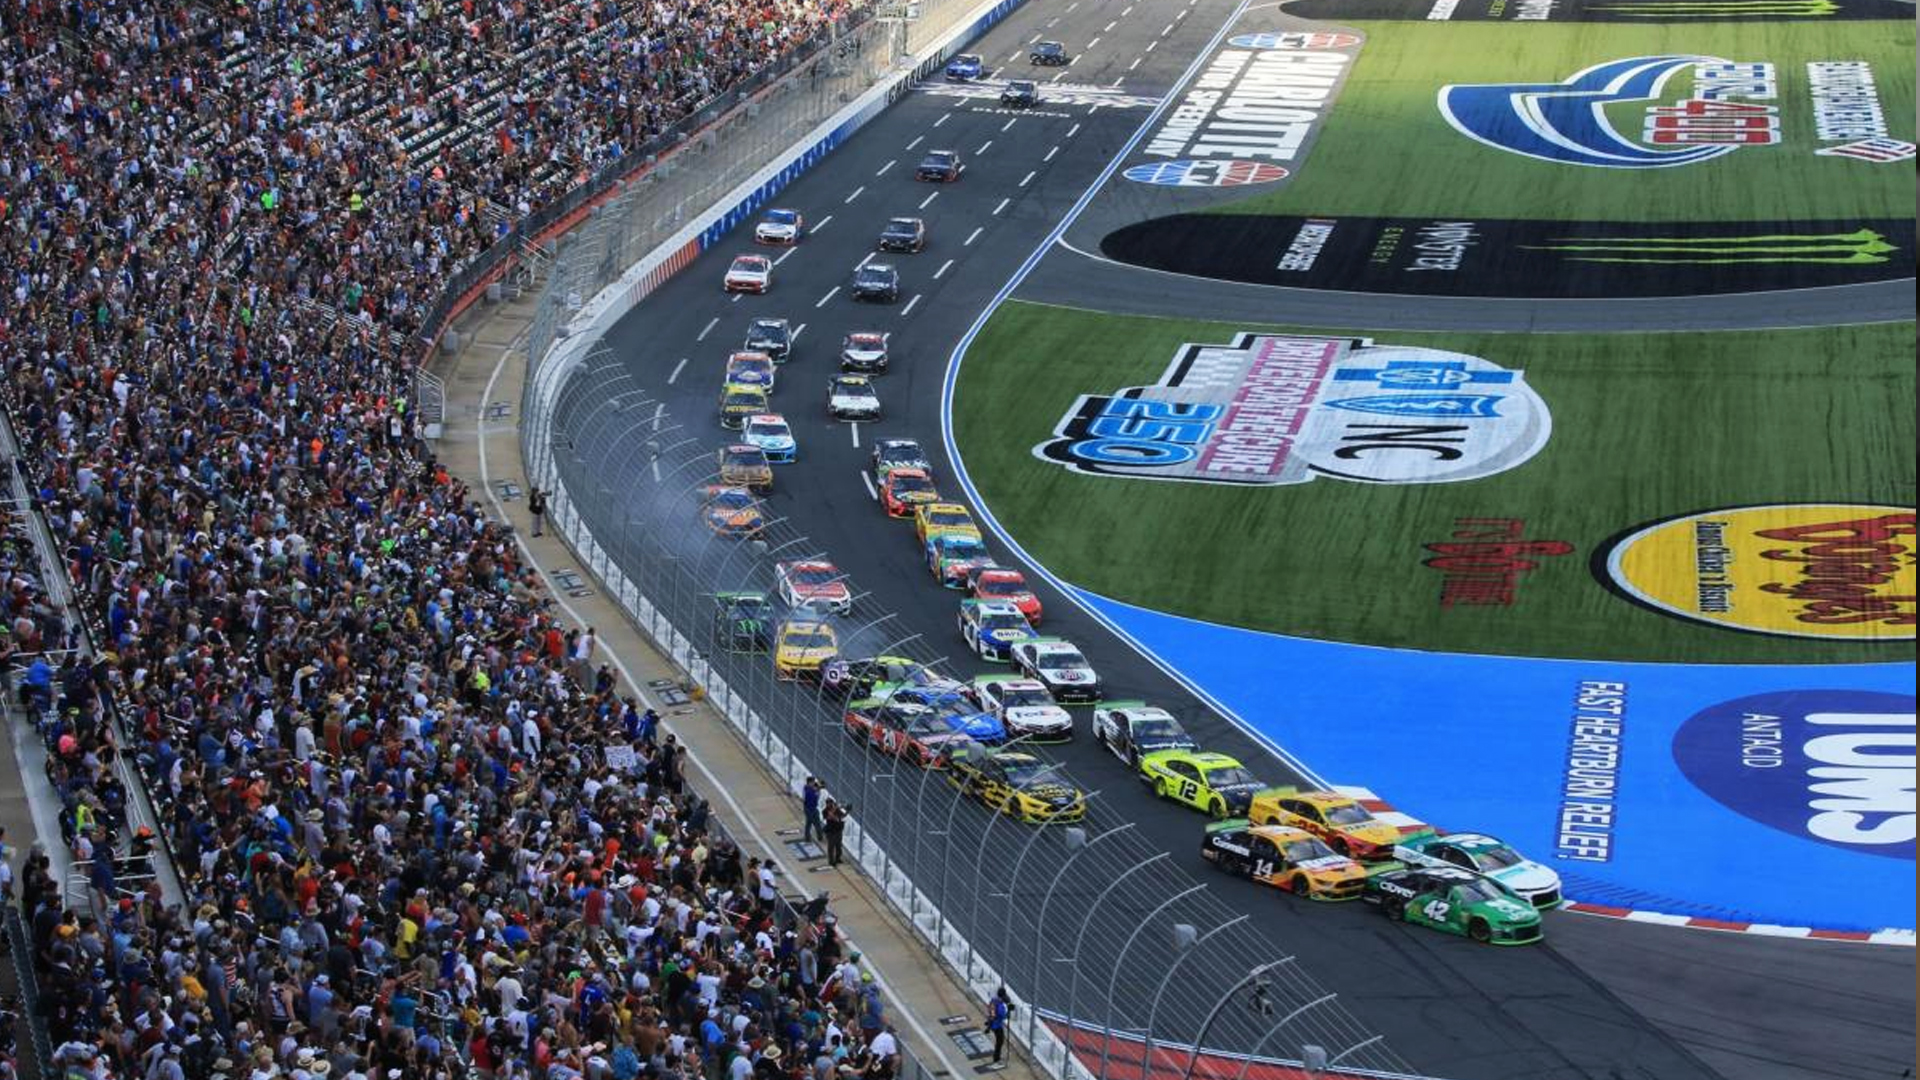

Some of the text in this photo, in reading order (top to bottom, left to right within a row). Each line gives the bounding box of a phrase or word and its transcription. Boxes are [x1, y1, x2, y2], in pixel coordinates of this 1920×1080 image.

[1144, 50, 1253, 158] MOTOR SPEEDWAY
[1189, 50, 1350, 160] CHARLOTTE
[1643, 99, 1782, 145] 400
[1369, 226, 1404, 263] ENERGY
[1403, 221, 1480, 271] MONSTER
[1254, 340, 1329, 379] DRIVE
[1245, 379, 1319, 404] FOR
[1069, 398, 1225, 464] 250
[1228, 405, 1309, 432] THE
[1207, 434, 1296, 474] CURE
[1333, 423, 1470, 461] NC
[1698, 583, 1735, 612] Biscuits
[1742, 713, 1782, 768] ANTACID
[1179, 778, 1198, 801] 12
[1558, 681, 1624, 862] FAST HEARTBURN RELIEF!
[1252, 858, 1274, 878] 14
[1423, 898, 1451, 923] 42
